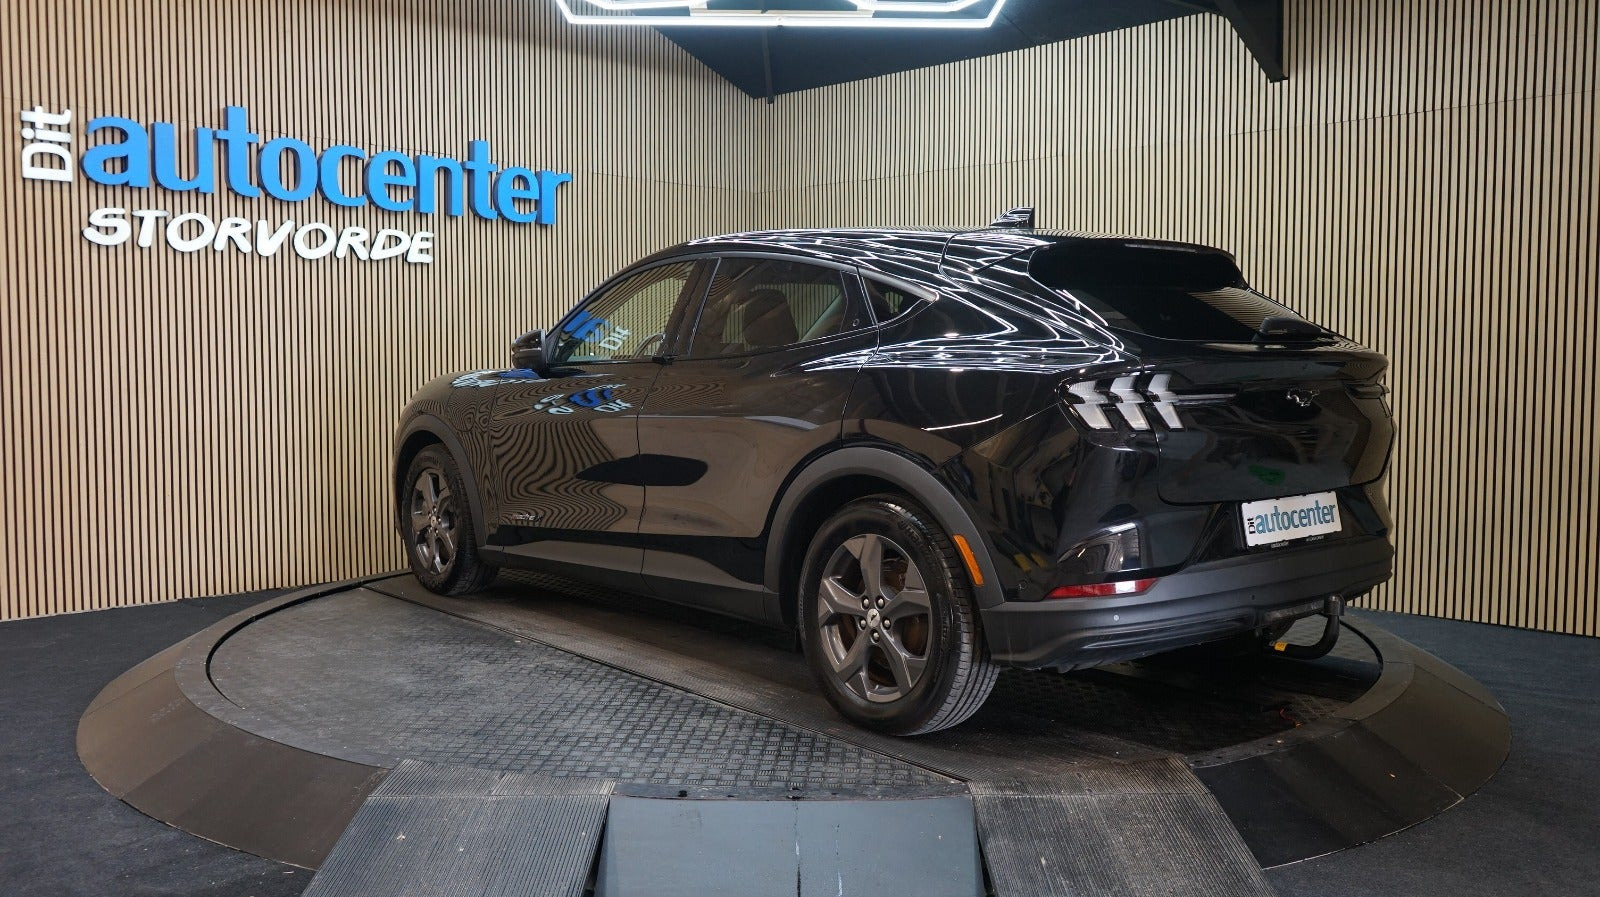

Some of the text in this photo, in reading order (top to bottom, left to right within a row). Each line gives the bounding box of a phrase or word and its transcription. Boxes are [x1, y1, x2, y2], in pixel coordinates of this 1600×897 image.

[20, 106, 73, 183] Dit
[82, 105, 573, 226] autocenter
[83, 207, 435, 263] STORVORDE
[1256, 501, 1336, 534] autocenter
